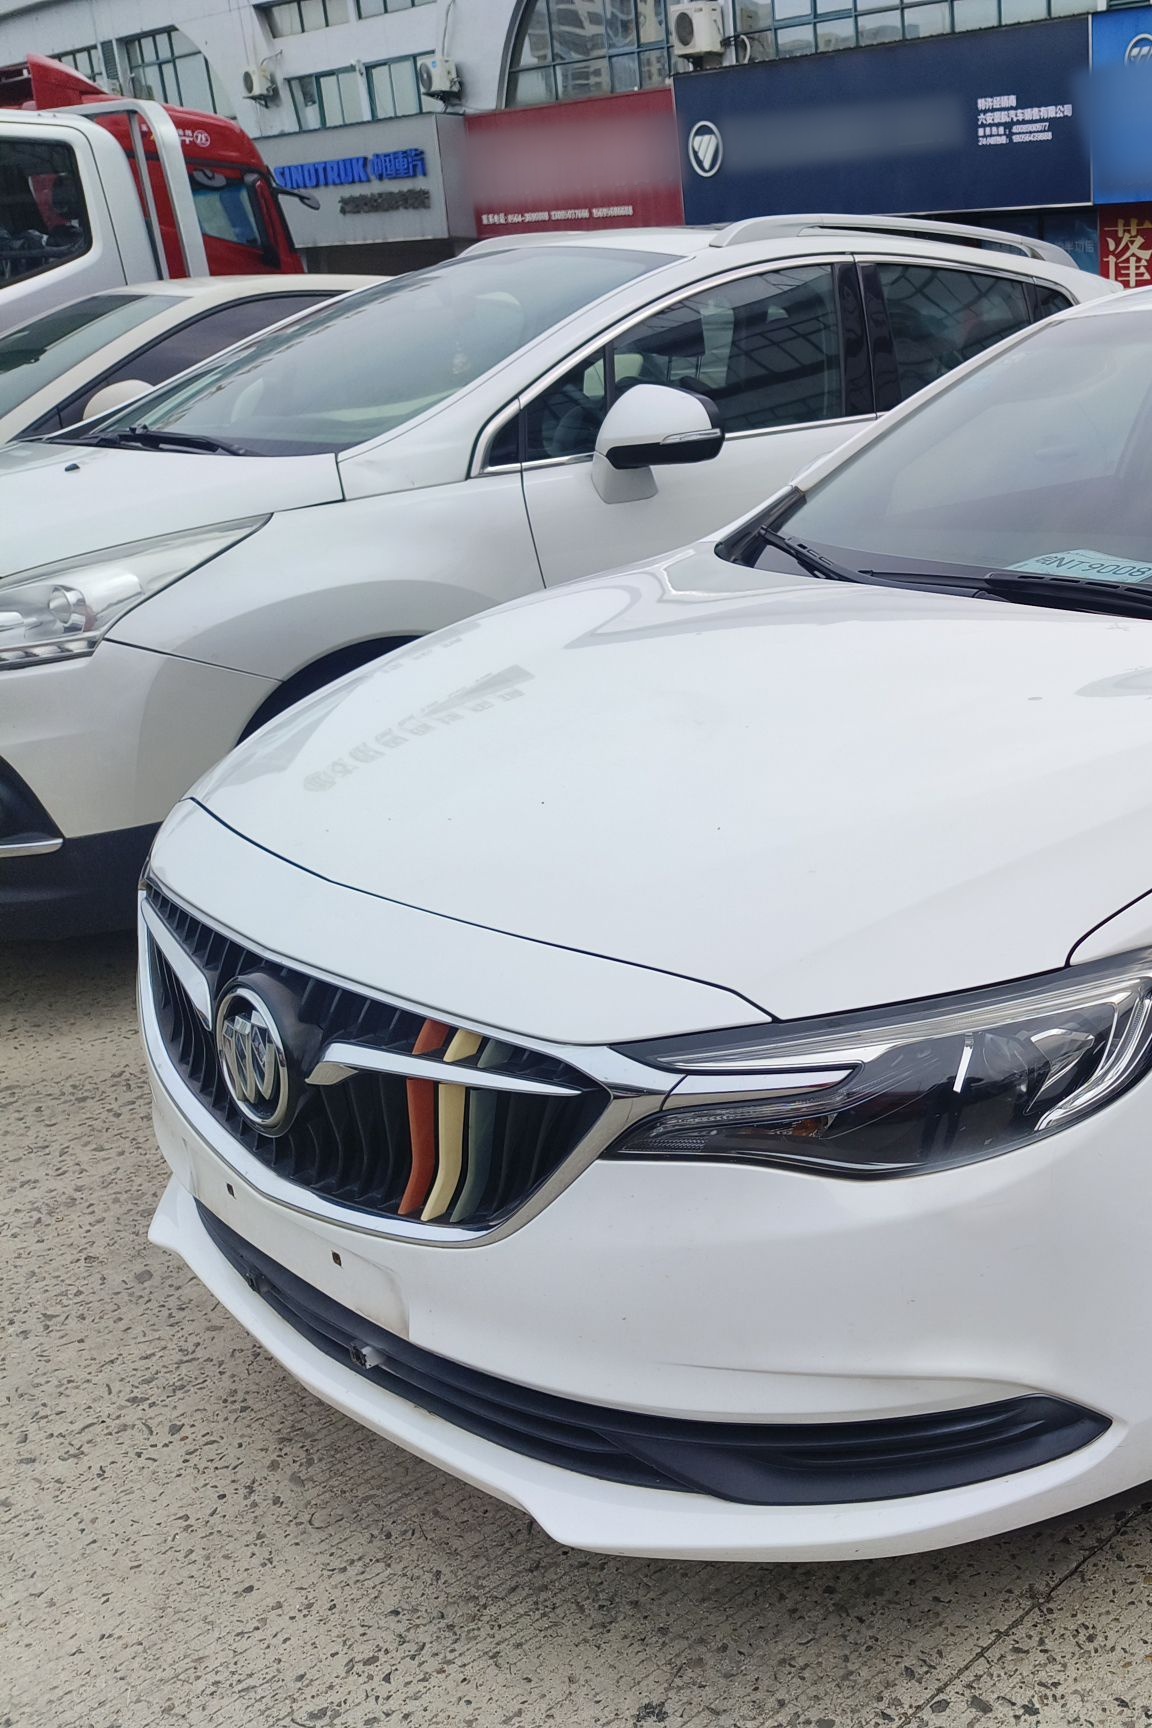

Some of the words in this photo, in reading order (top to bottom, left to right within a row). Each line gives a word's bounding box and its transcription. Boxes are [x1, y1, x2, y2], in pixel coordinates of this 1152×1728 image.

[273, 156, 371, 190] SINOTRUK
[371, 148, 428, 181] 中国重汽
